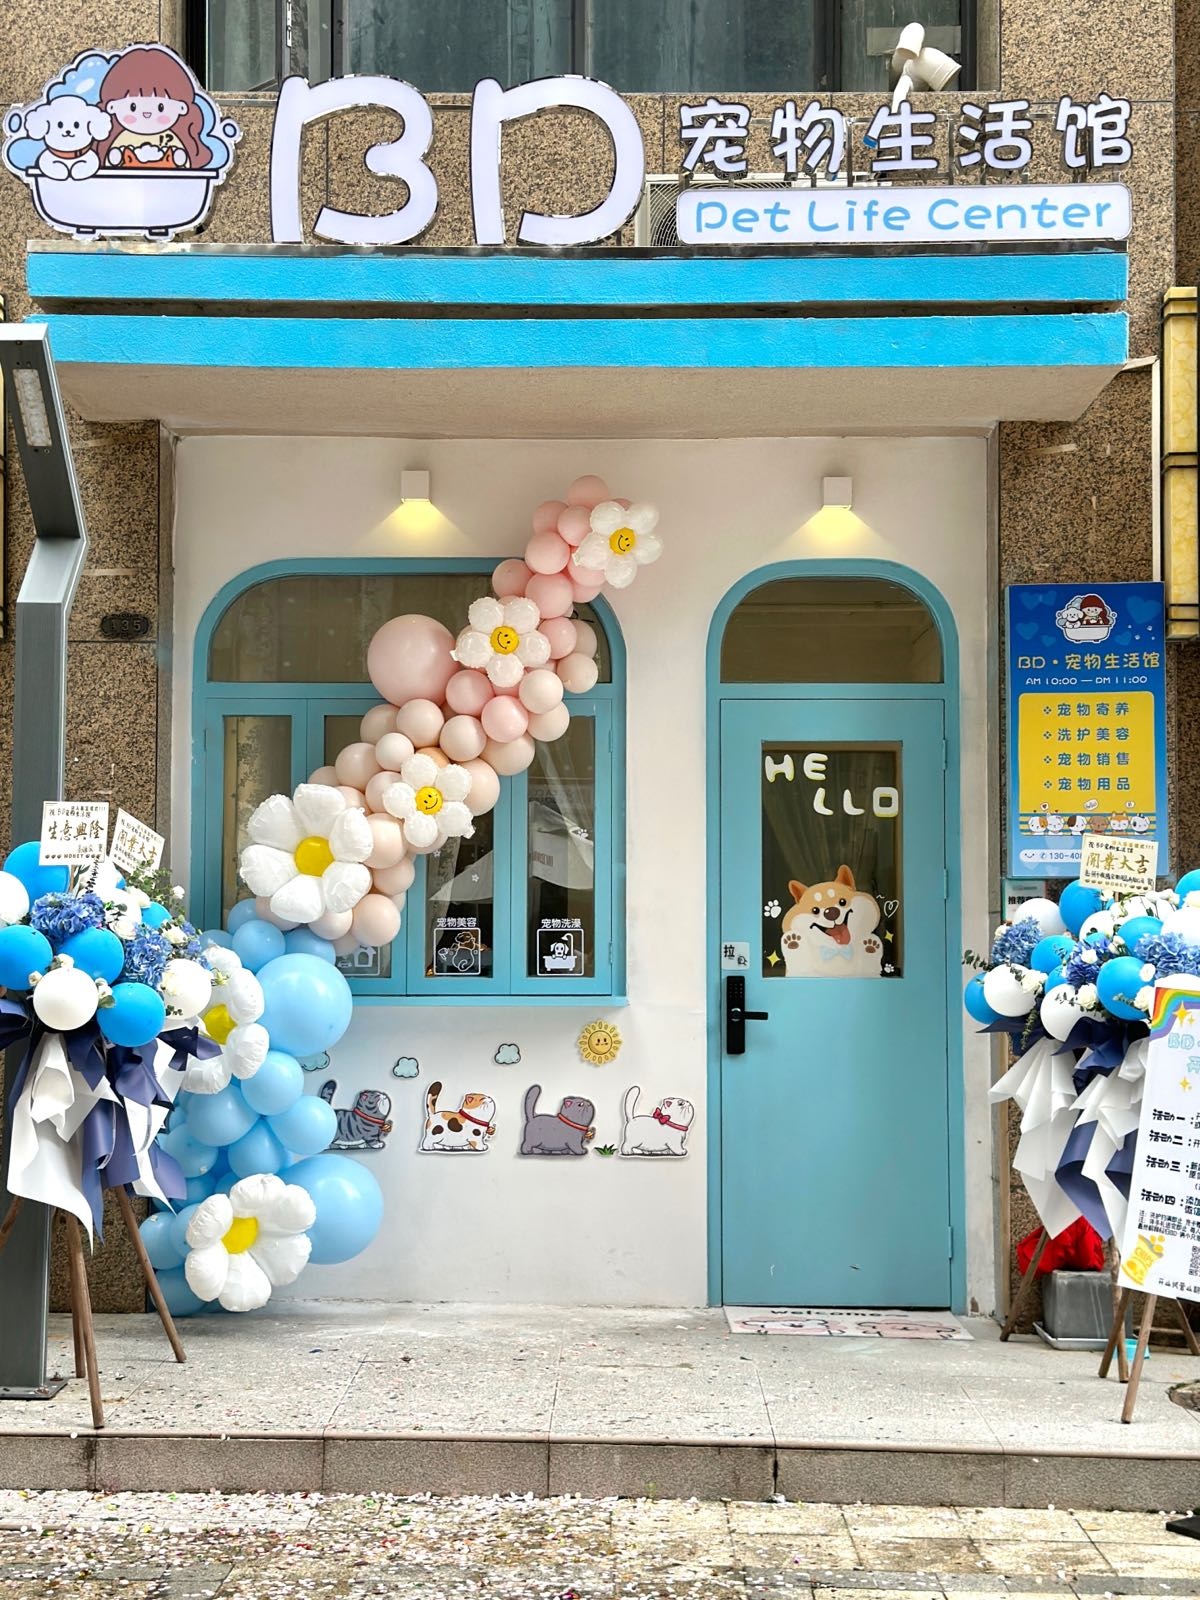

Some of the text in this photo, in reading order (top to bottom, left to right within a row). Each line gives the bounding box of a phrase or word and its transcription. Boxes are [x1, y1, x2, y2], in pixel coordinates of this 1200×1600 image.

[678, 92, 1134, 178] 宠物生活馆
[271, 74, 646, 247] BD
[695, 197, 1112, 233] Pet Life Center
[1046, 676, 1077, 685] 10:00
[1057, 702, 1129, 716] 宠物寄养
[1057, 727, 1130, 742] 洗护美容
[1057, 752, 1130, 766] 宠物销售
[1058, 777, 1131, 791] 宠物用品
[1049, 851, 1083, 860] 130-40
[436, 917, 477, 928] 宠物美容
[541, 918, 582, 929] 宠物洗澡
[723, 944, 736, 959] 拉
